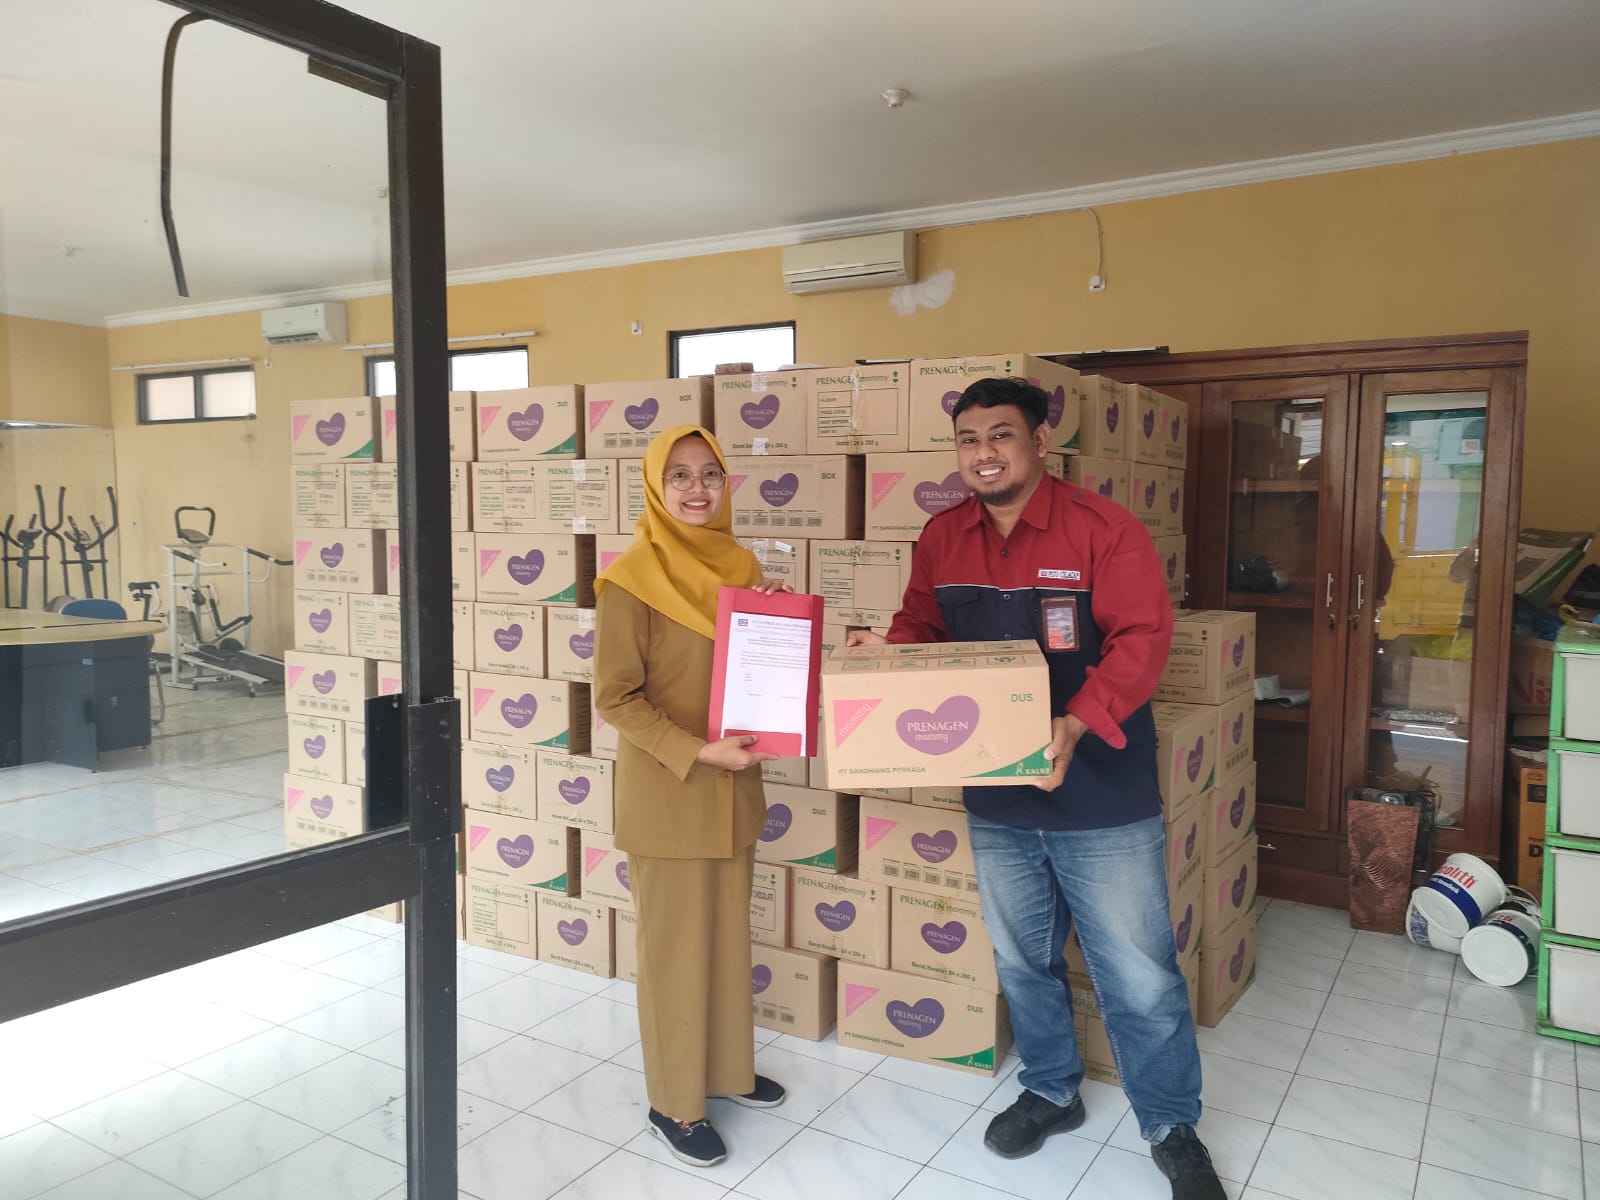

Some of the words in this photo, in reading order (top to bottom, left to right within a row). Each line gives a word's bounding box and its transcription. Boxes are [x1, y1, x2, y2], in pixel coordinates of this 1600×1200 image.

[920, 365, 966, 375] PRENAGEN
[816, 376, 857, 385] PRENAGE
[679, 394, 692, 402] BOX
[819, 548, 860, 557] PRENAGEN
[1011, 693, 1033, 702] DUS
[504, 707, 532, 715] PRENAGEN
[839, 703, 872, 737] mommy
[907, 721, 968, 732] PRENAGEN
[915, 732, 949, 743] mommy
[766, 819, 785, 827] AGEN
[917, 843, 951, 854] PRENAGEN
[797, 877, 838, 891] PRENAGEN
[543, 898, 572, 910] PRENAGEN
[900, 895, 944, 910] PRENAGEN
[947, 906, 976, 917] mommy
[820, 909, 850, 921] PRENAGEN
[927, 931, 960, 942] PRENAGEN
[968, 1005, 983, 1013] DUS
[893, 1009, 936, 1024] PRENAGEN
